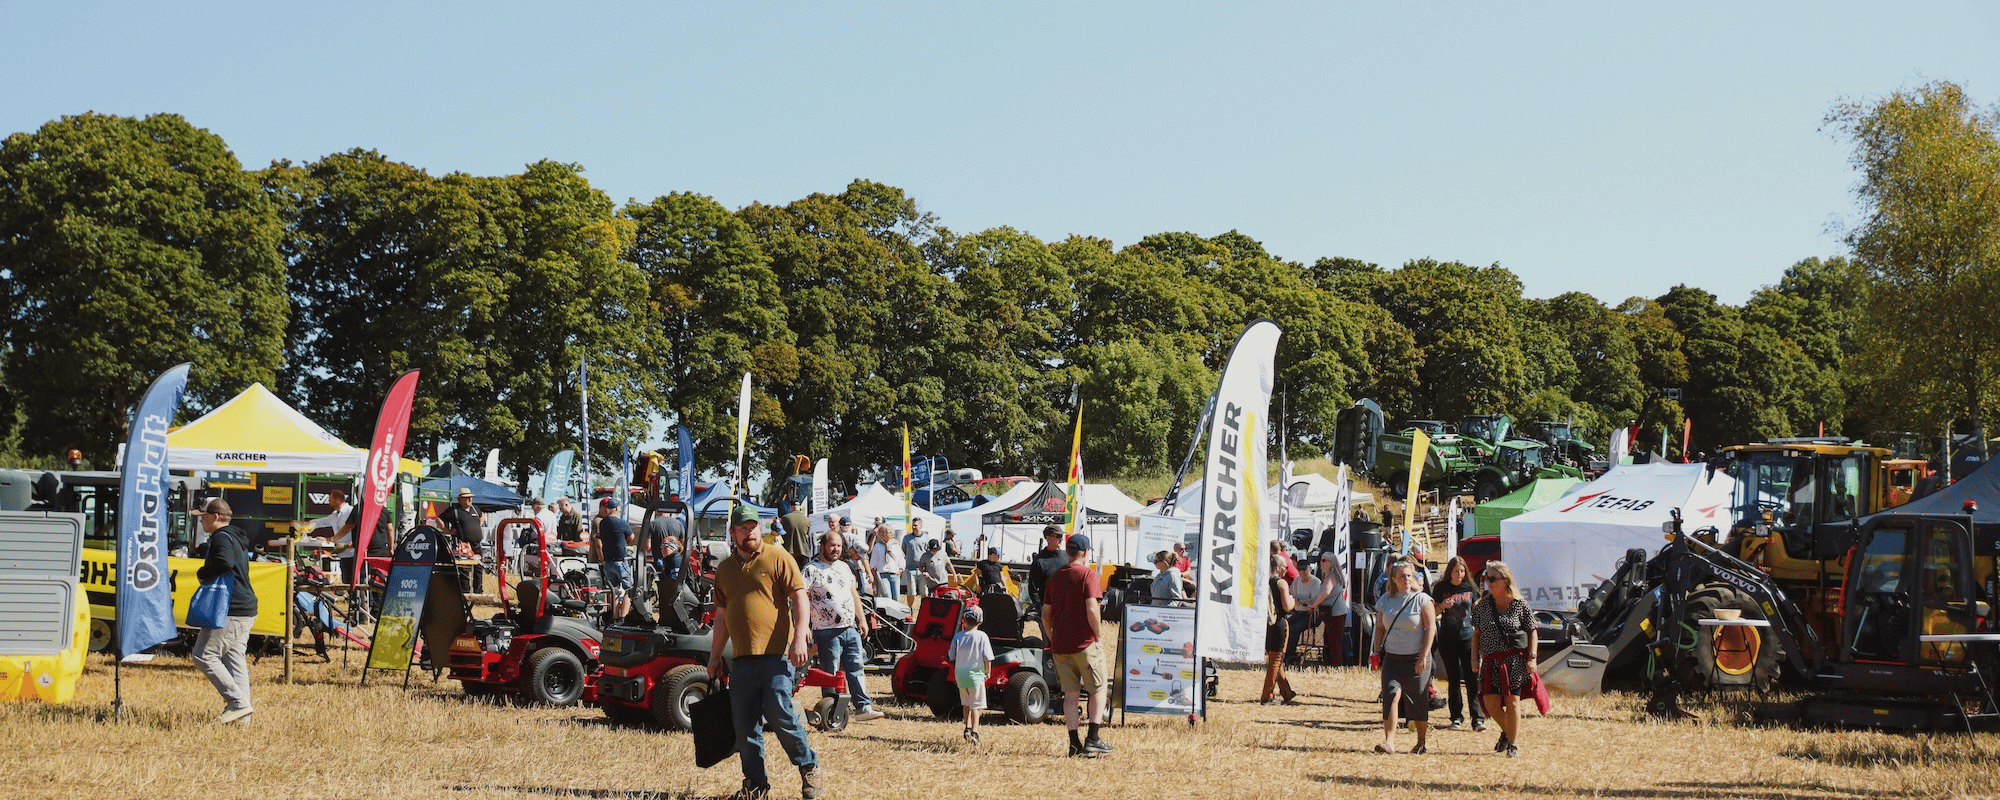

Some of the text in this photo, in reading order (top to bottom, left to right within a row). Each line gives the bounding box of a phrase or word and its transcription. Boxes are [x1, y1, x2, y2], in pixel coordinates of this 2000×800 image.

[375, 432, 394, 503] CRAMER
[552, 464, 567, 491] Råd
[126, 414, 168, 592] ÖstraHult
[1209, 401, 1242, 605] KÄRCHER
[1588, 494, 1655, 511] TEFAB
[406, 542, 431, 551] CRAMER
[400, 579, 419, 589] 100%
[1712, 565, 1757, 593] VOLVO
[456, 639, 475, 648] FERRIS
